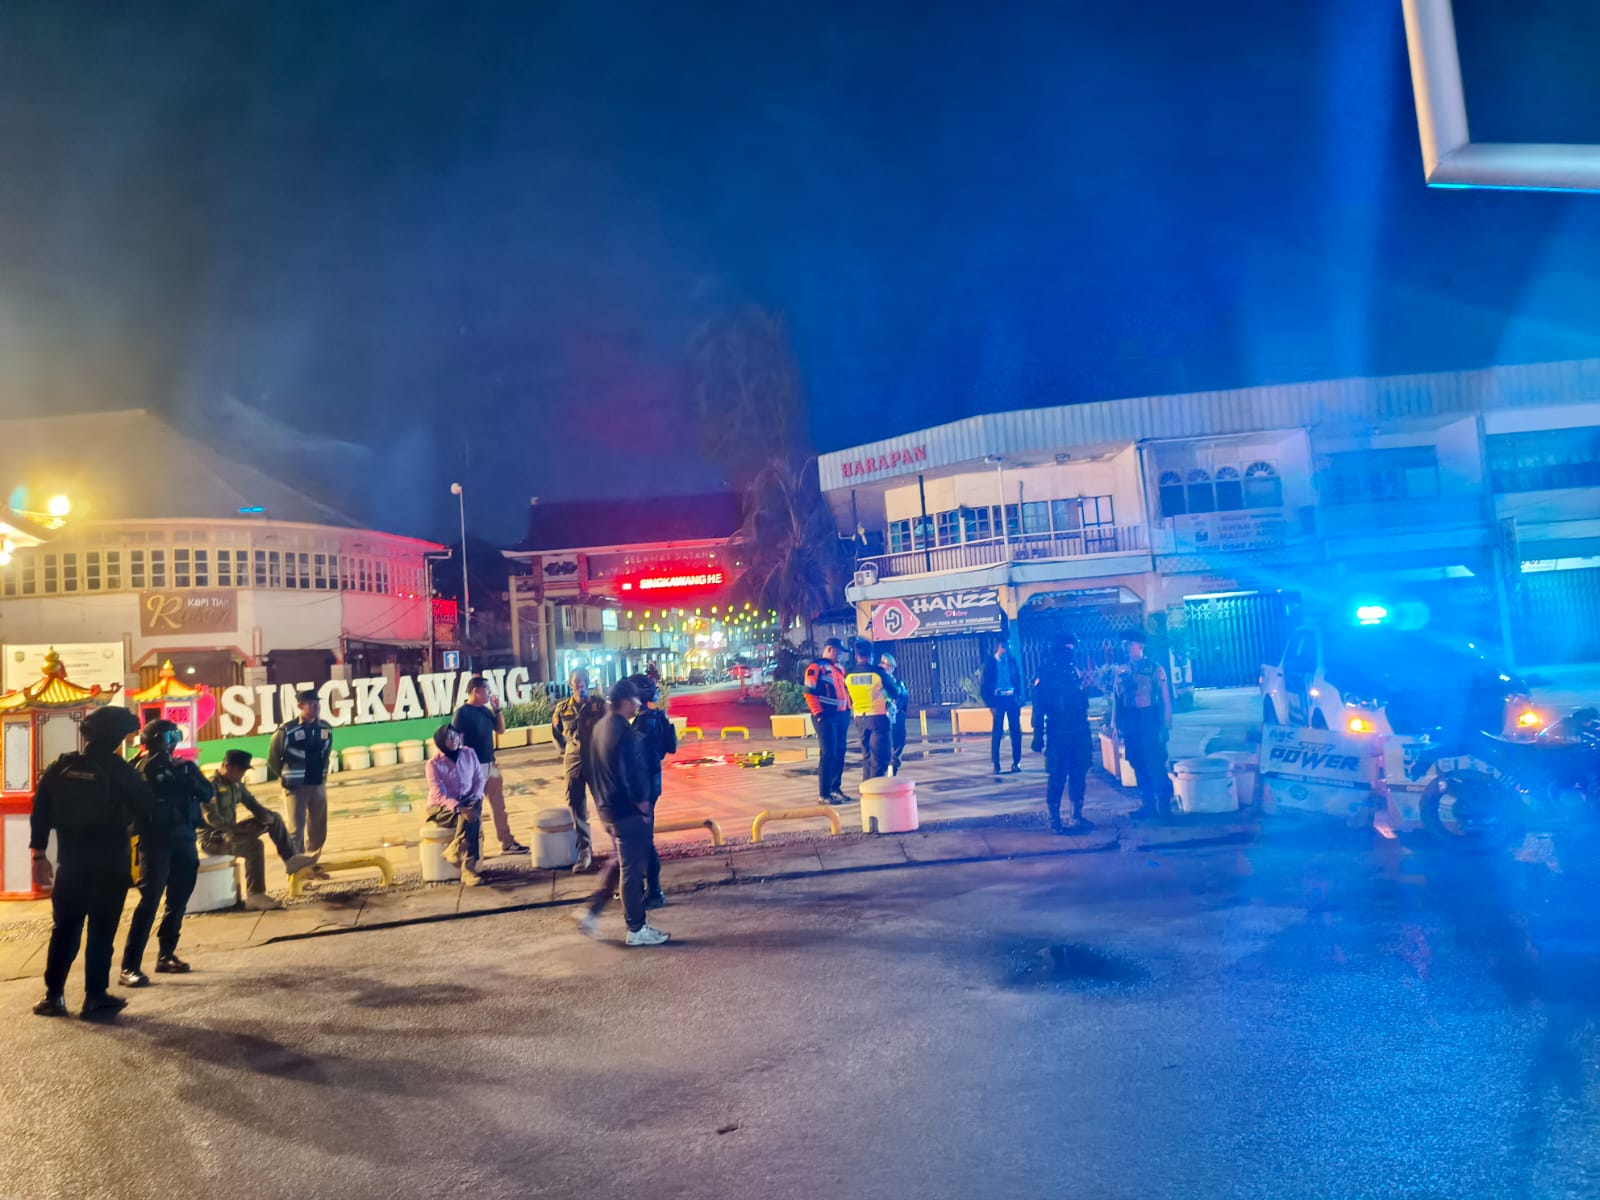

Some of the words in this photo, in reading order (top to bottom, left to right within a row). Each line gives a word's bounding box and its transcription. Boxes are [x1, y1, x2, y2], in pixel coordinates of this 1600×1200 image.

[841, 444, 927, 478] HARAPAN
[639, 575, 706, 590] SINGKAWANG
[707, 573, 723, 585] HE
[187, 597, 209, 608] KOPI
[911, 592, 997, 614] HANZZ
[1269, 747, 1361, 772] POWER
